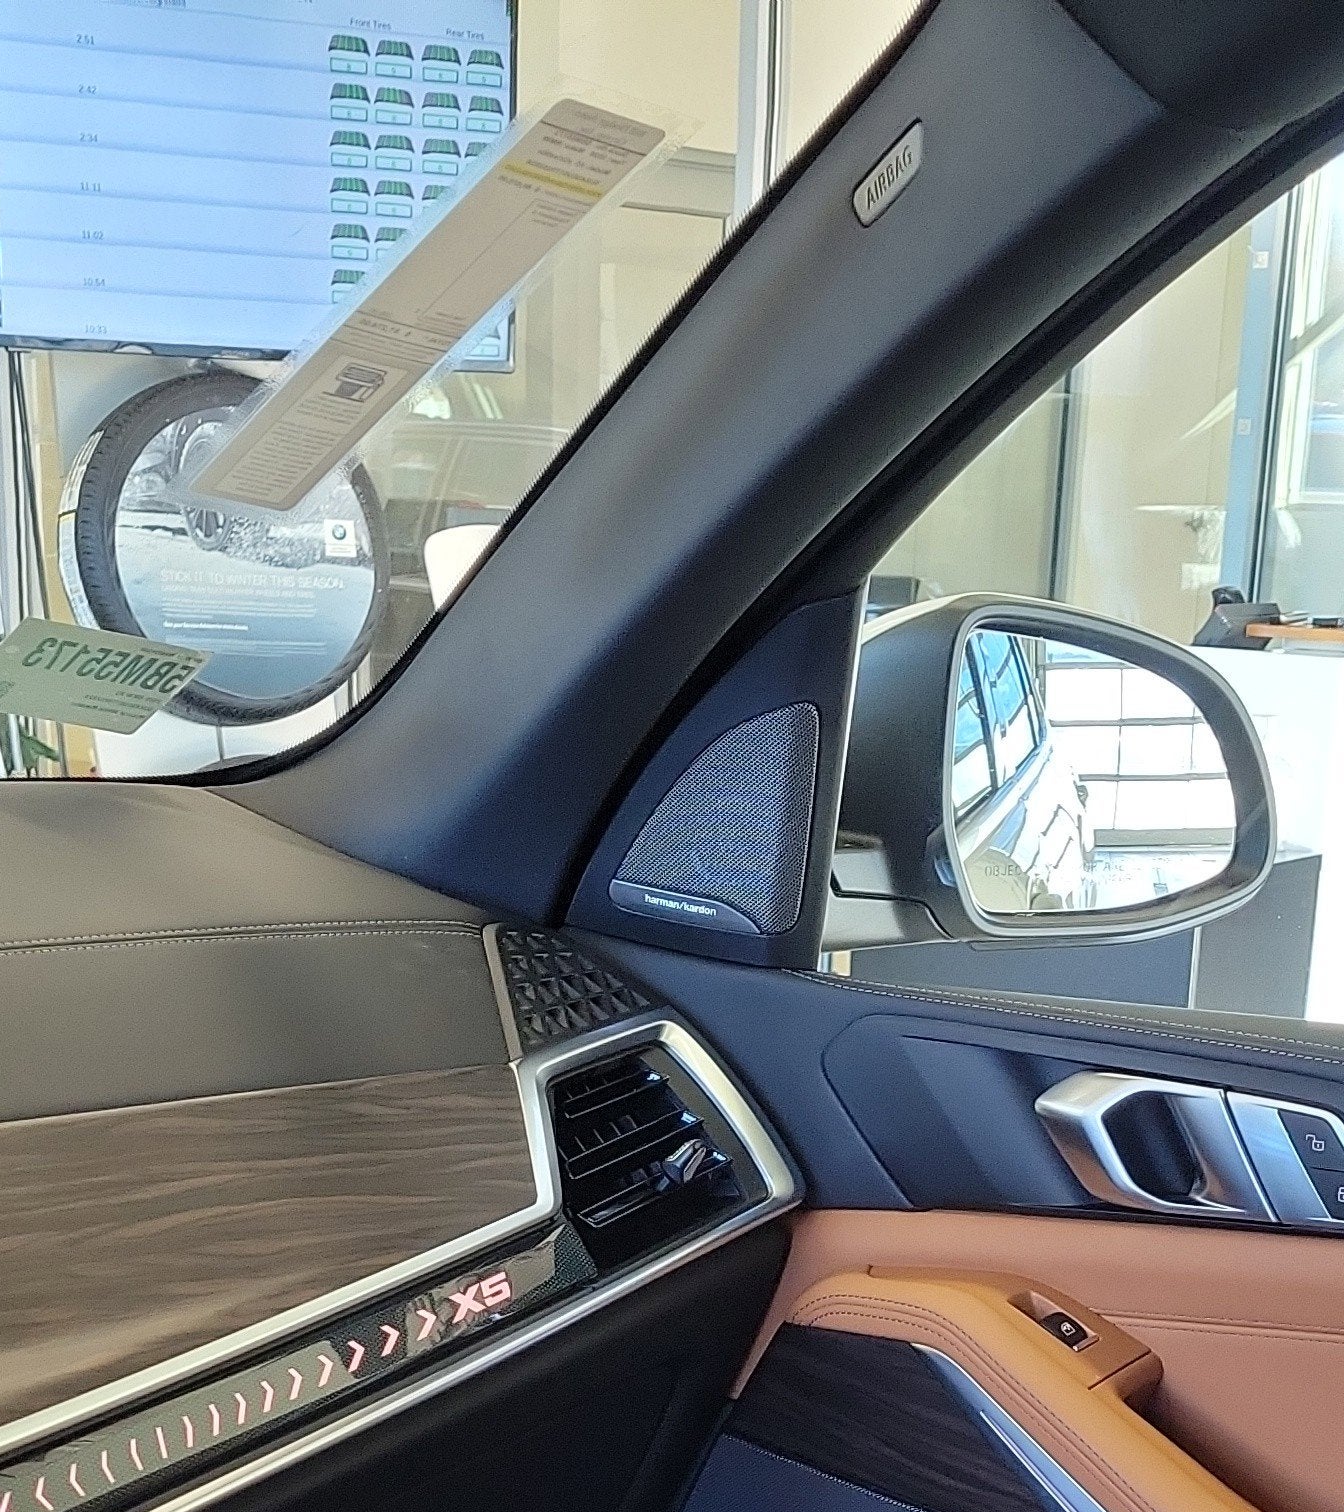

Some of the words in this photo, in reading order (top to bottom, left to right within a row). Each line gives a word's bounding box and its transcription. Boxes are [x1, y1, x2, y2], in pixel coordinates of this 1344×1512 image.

[76, 33, 95, 46] 251
[78, 84, 97, 95] 242
[80, 132, 98, 143] 234
[866, 144, 913, 210] AIRBAG
[80, 182, 101, 192] 1111
[82, 230, 104, 241] 1102
[83, 278, 105, 287] 1054
[85, 324, 107, 335] 1033
[227, 574, 269, 587] WINTER
[644, 893, 717, 916] harman/kardon
[444, 1271, 513, 1325] X5
